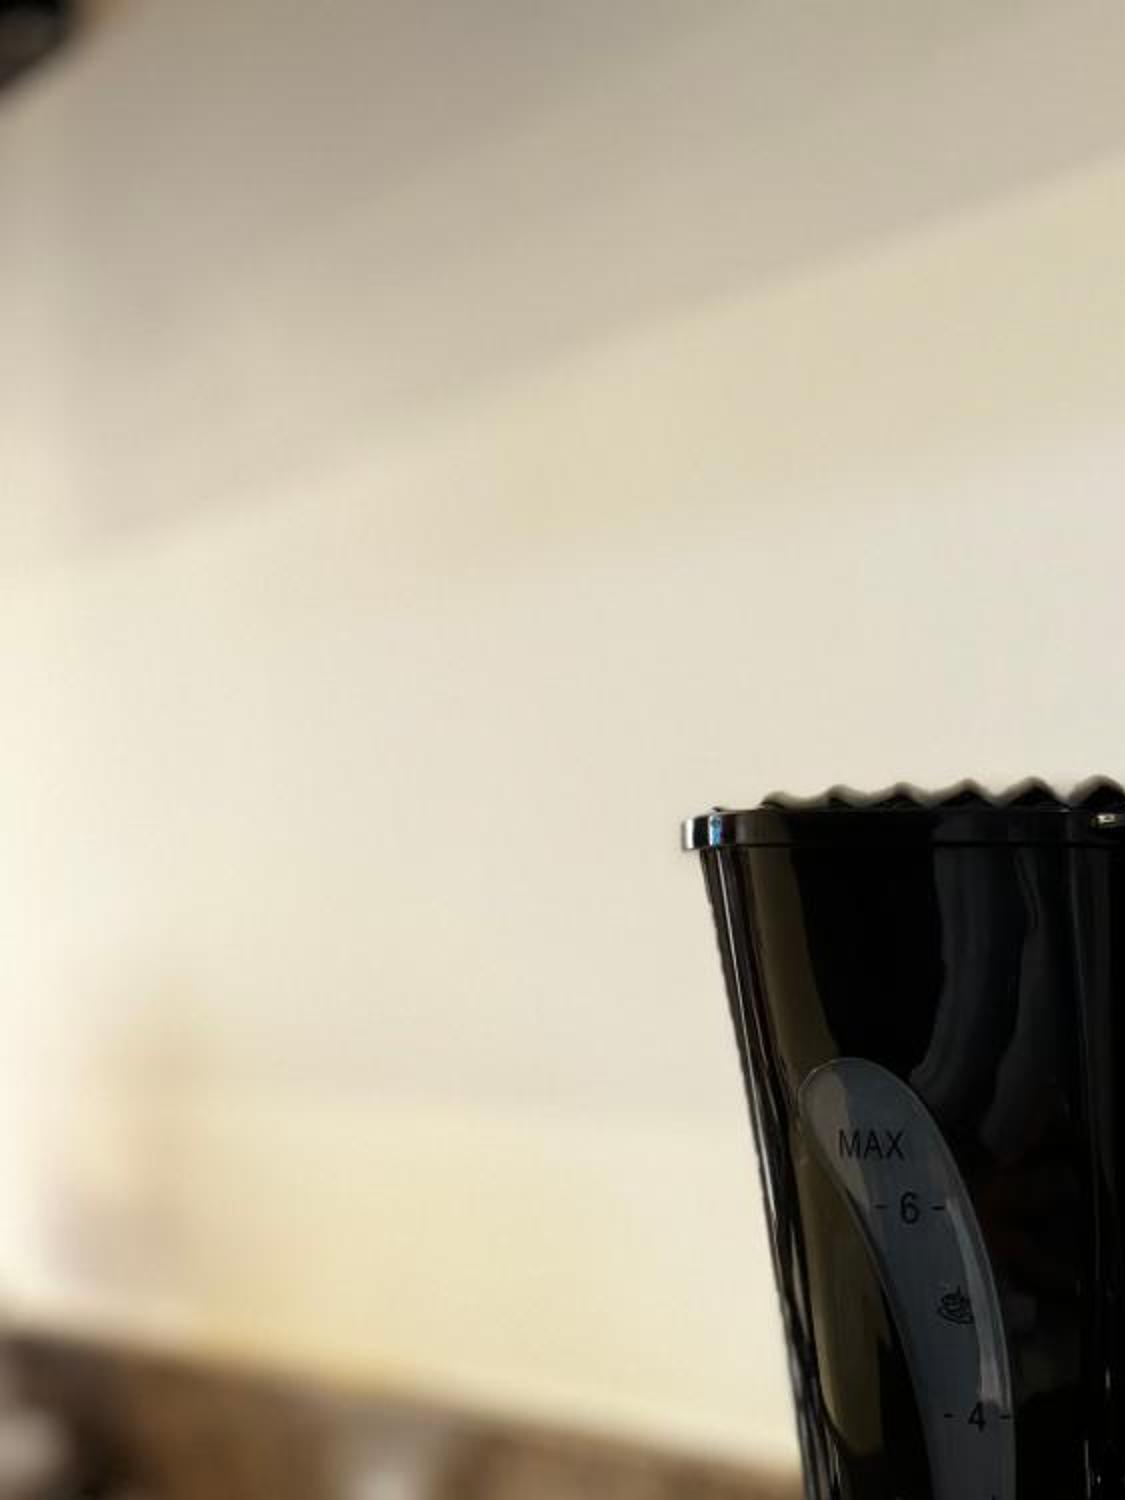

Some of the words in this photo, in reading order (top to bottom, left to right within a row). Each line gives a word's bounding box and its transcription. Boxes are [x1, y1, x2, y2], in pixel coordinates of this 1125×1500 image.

[838, 1129, 905, 1160] MAX
[900, 1191, 921, 1225] 6
[967, 1401, 987, 1433] 4
